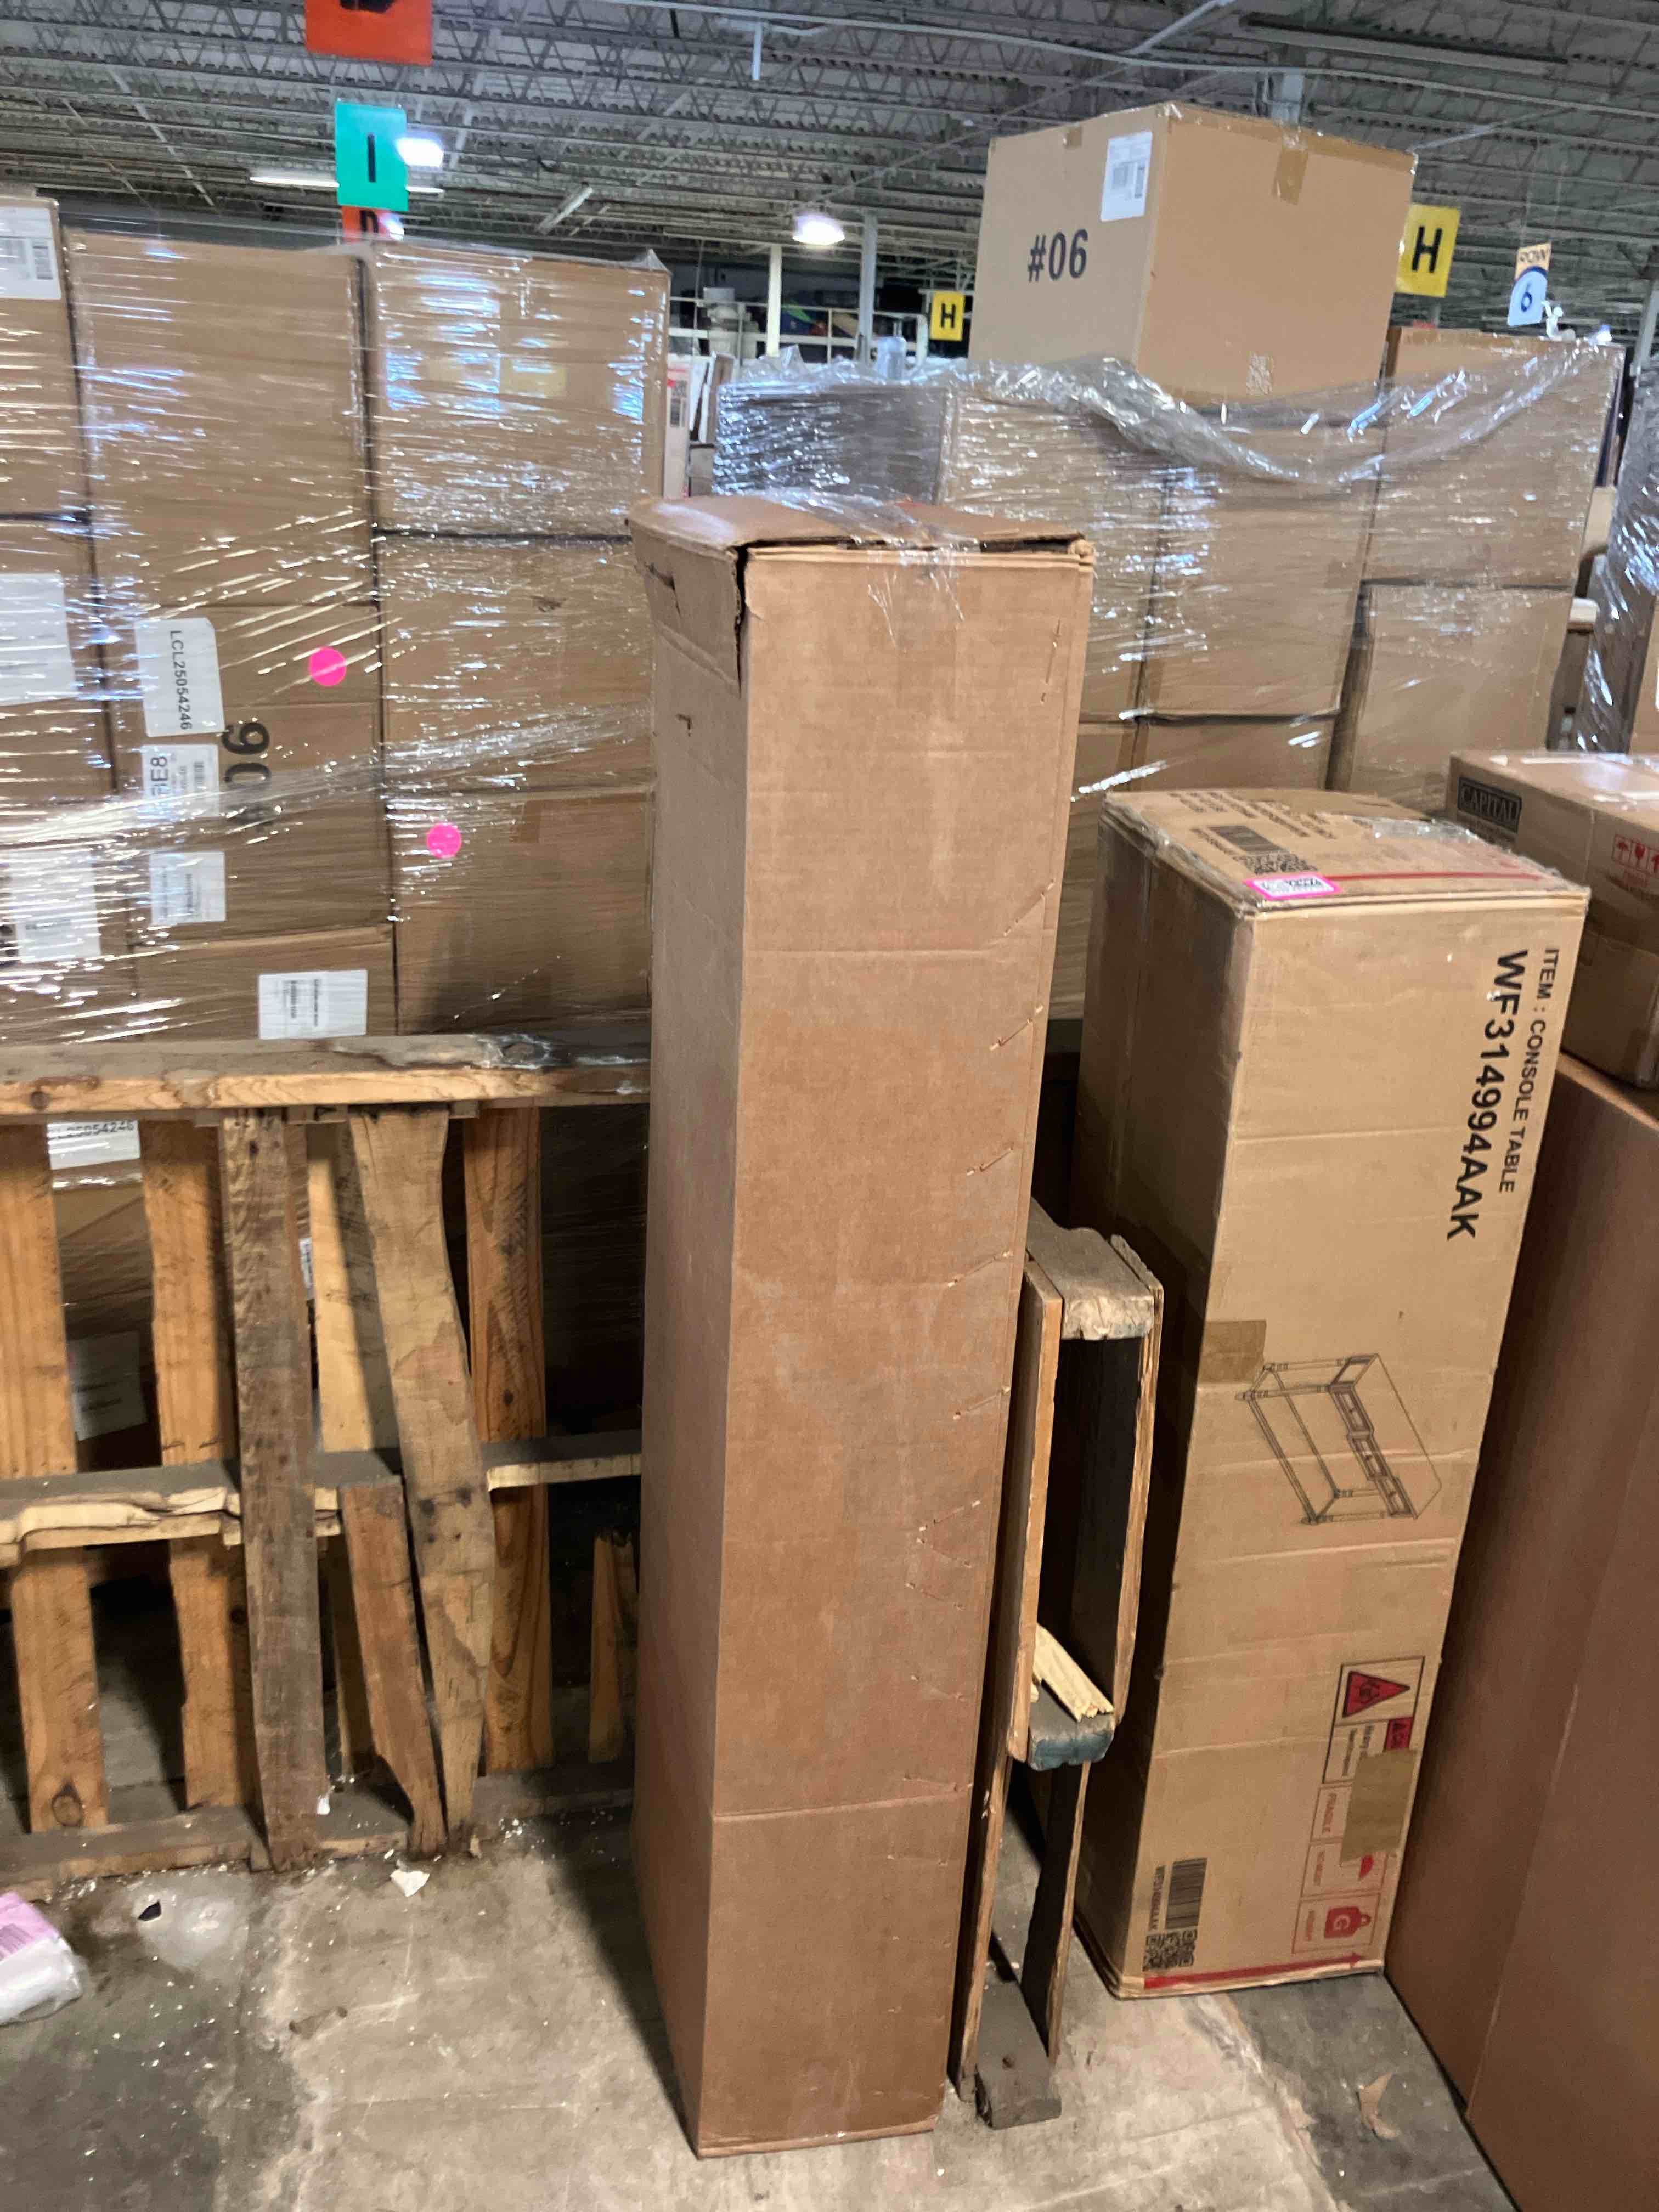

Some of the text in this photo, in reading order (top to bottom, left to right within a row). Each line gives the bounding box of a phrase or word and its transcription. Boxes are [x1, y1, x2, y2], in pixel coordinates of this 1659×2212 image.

[1028, 229, 1089, 283] #06
[1411, 225, 1443, 274] H
[940, 303, 957, 329] H
[170, 630, 193, 730] LCL25054246
[1537, 947, 1560, 1000] ITEM
[1447, 949, 1528, 1240] WF314994AAK
[1513, 1019, 1546, 1122] CONSOLE
[1499, 1128, 1525, 1194] TABLE
